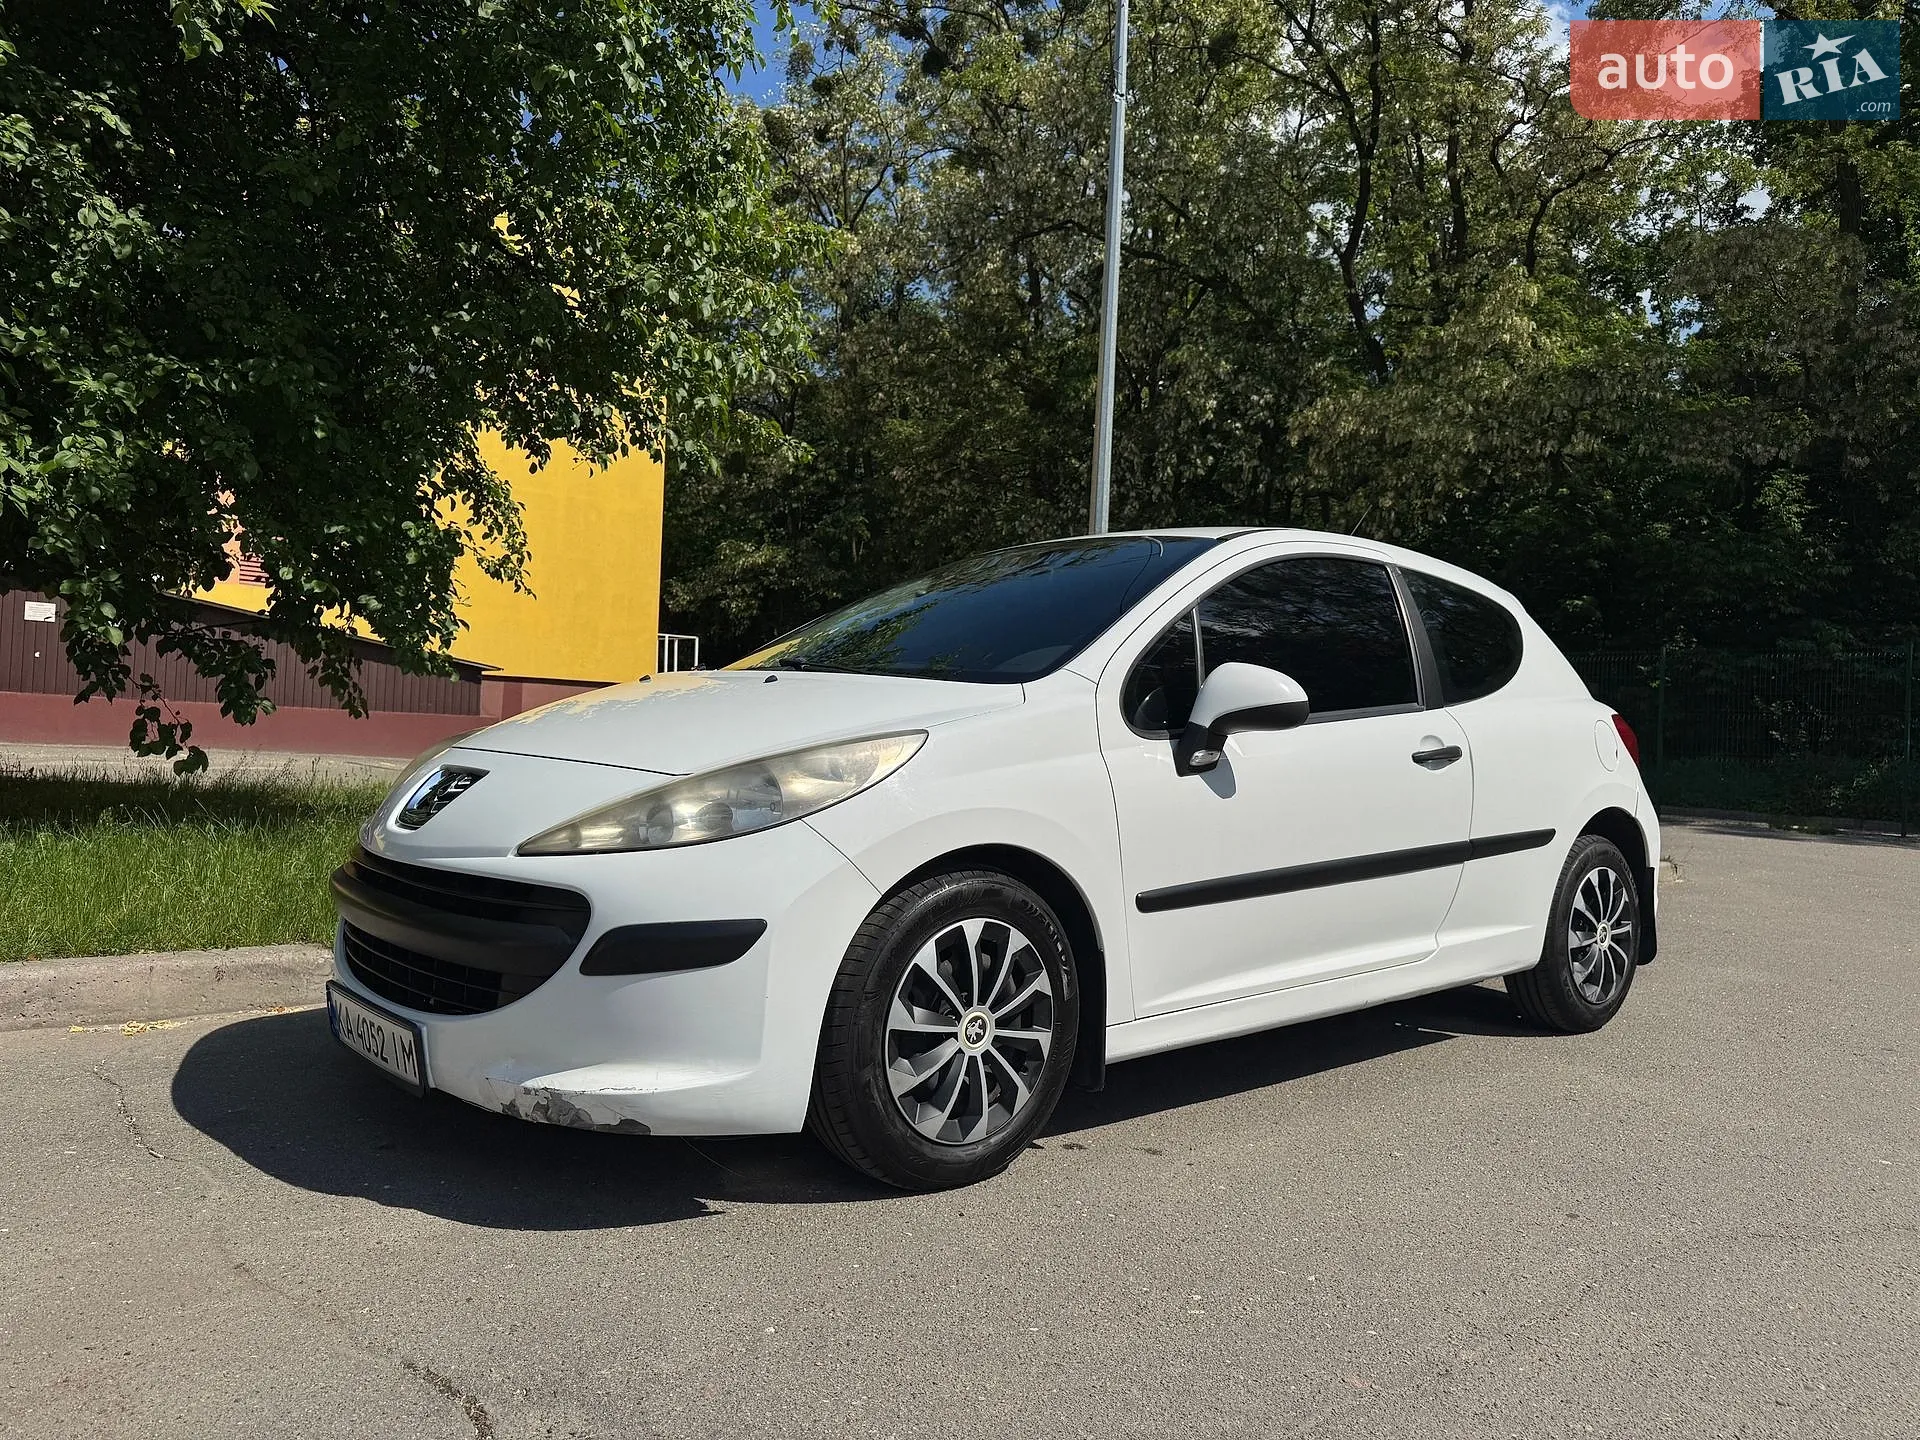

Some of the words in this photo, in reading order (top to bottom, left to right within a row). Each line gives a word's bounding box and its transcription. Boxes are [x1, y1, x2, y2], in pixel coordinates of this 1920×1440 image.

[334, 999, 356, 1044] KA
[356, 1014, 389, 1064] 4052
[392, 1031, 418, 1079] IM
